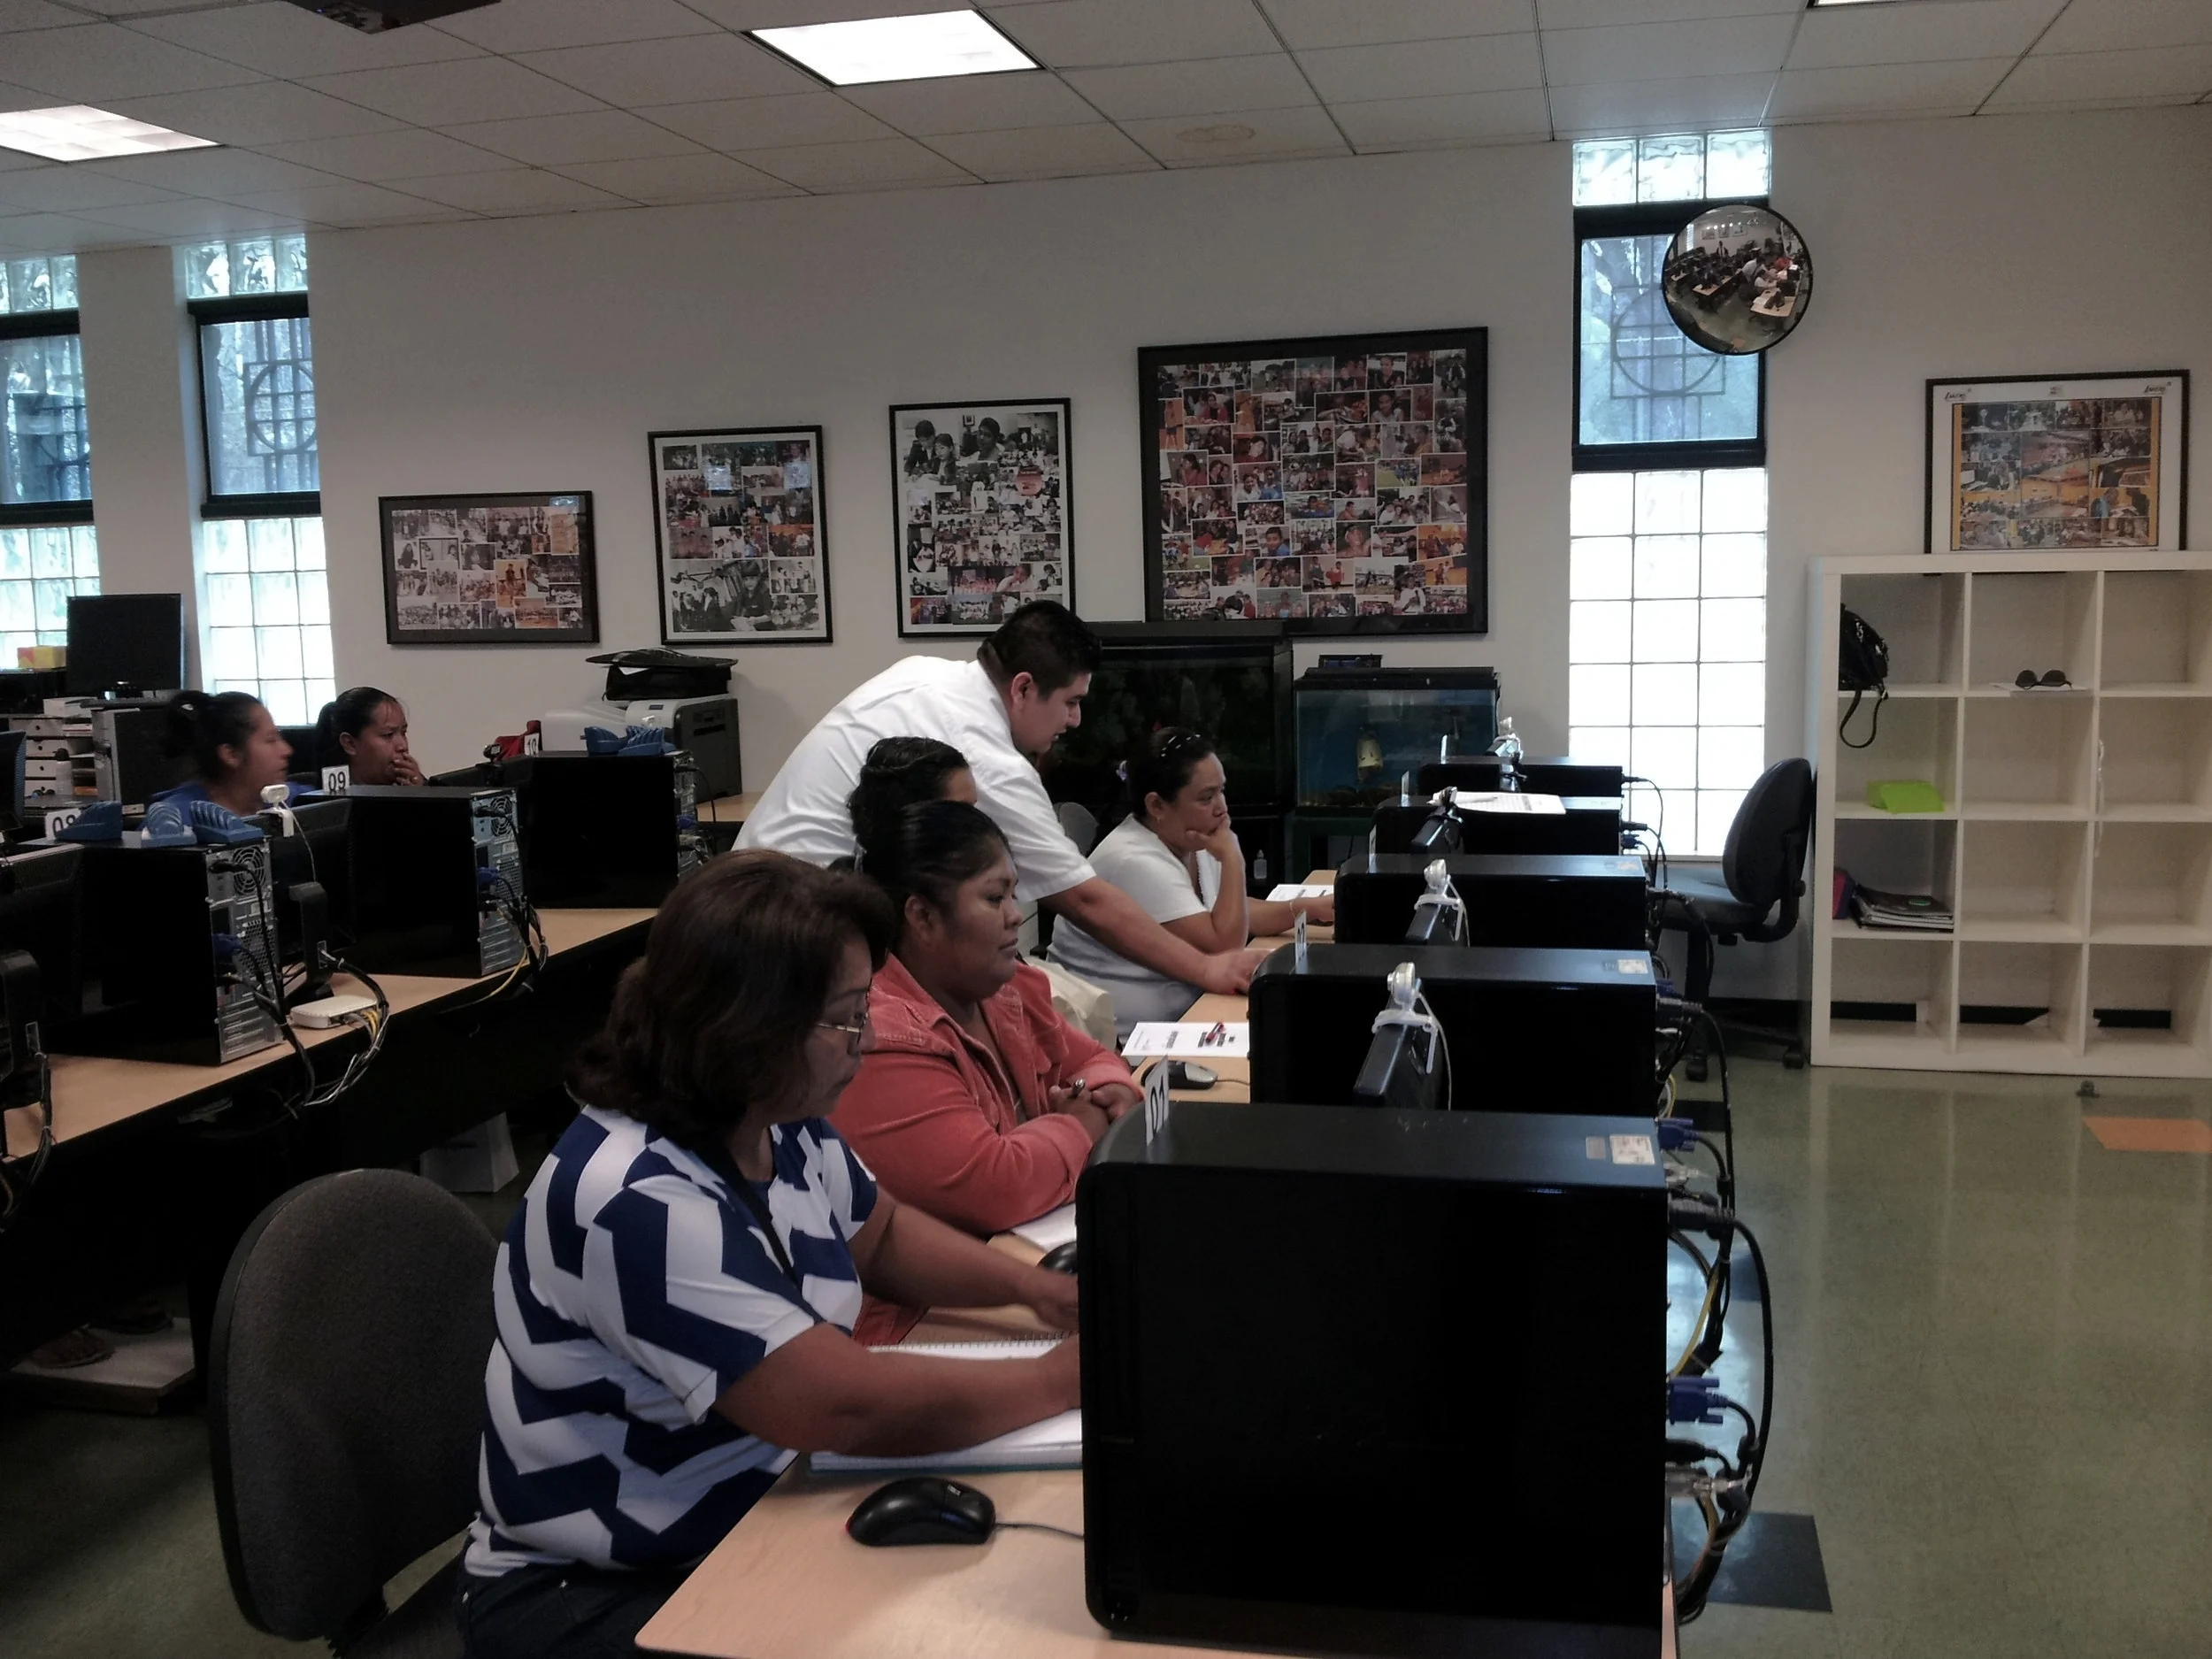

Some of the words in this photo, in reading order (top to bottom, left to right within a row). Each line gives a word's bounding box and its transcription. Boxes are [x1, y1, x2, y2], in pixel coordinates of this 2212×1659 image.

[527, 738, 536, 754] 10
[328, 772, 346, 790] 09
[1150, 1074, 1165, 1137] 01
